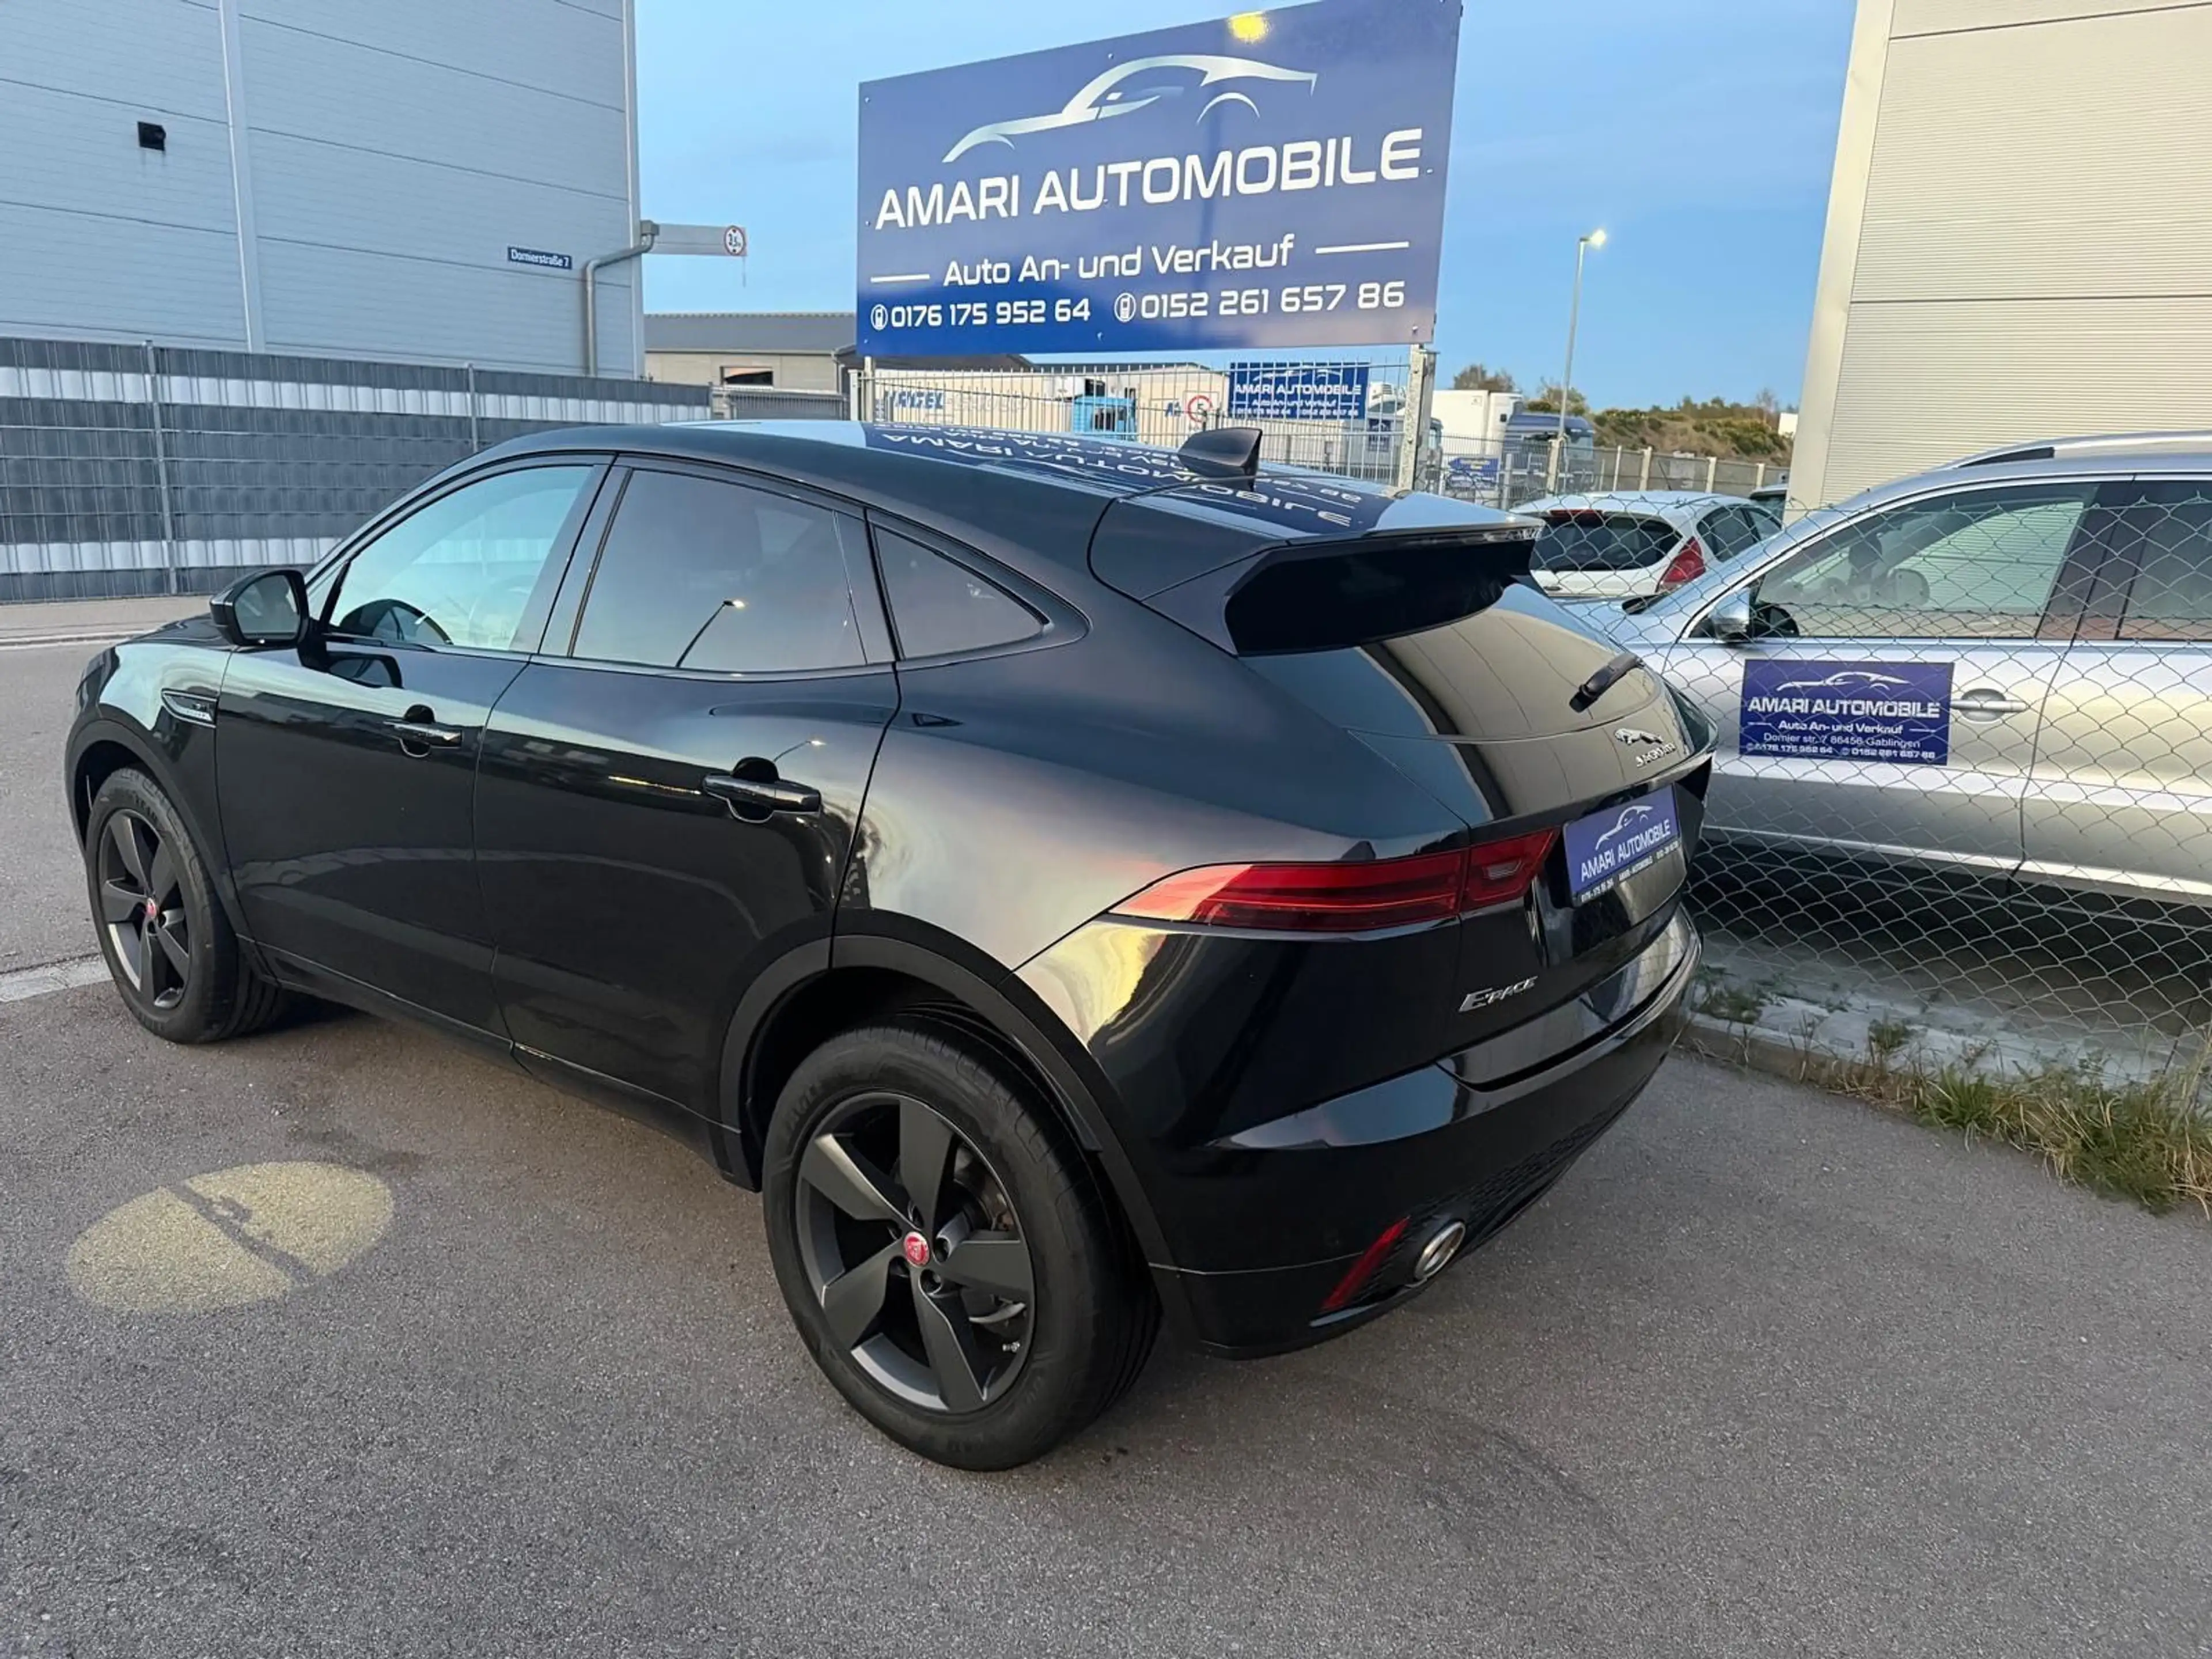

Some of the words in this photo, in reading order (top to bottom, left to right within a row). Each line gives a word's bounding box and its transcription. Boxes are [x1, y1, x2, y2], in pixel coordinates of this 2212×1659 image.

[876, 175, 1018, 230] AMARI
[1033, 128, 1422, 214] AUTOMOBILE
[511, 248, 563, 266] Dornierstraße
[563, 257, 569, 267] 7
[944, 259, 1010, 286] Auto
[1018, 256, 1070, 282] An-
[1078, 245, 1142, 278] und
[1152, 233, 1294, 274] Verkauf
[892, 305, 942, 327] 0176
[950, 302, 987, 326] 175
[996, 300, 1046, 325] 952
[1055, 298, 1090, 322] 64
[1141, 291, 1209, 320] 0152
[1219, 289, 1269, 316] 261
[1280, 285, 1346, 312] 657
[1358, 281, 1406, 309] 86
[1276, 384, 1361, 395] AUTOMOBILE
[1747, 697, 1809, 713] AMARI
[1811, 698, 1941, 718] AUTOMOBILE
[1778, 720, 1808, 730] Auto
[1809, 722, 1830, 731] An-
[1832, 723, 1854, 732] und
[1855, 723, 1903, 733] Verkauf
[1764, 732, 1800, 742] Dornier
[1866, 737, 1921, 749] Gablingen
[1636, 742, 1677, 768] JAGUAR
[1581, 848, 1616, 882] AMARI
[1618, 818, 1671, 863] AUTOMOBILE
